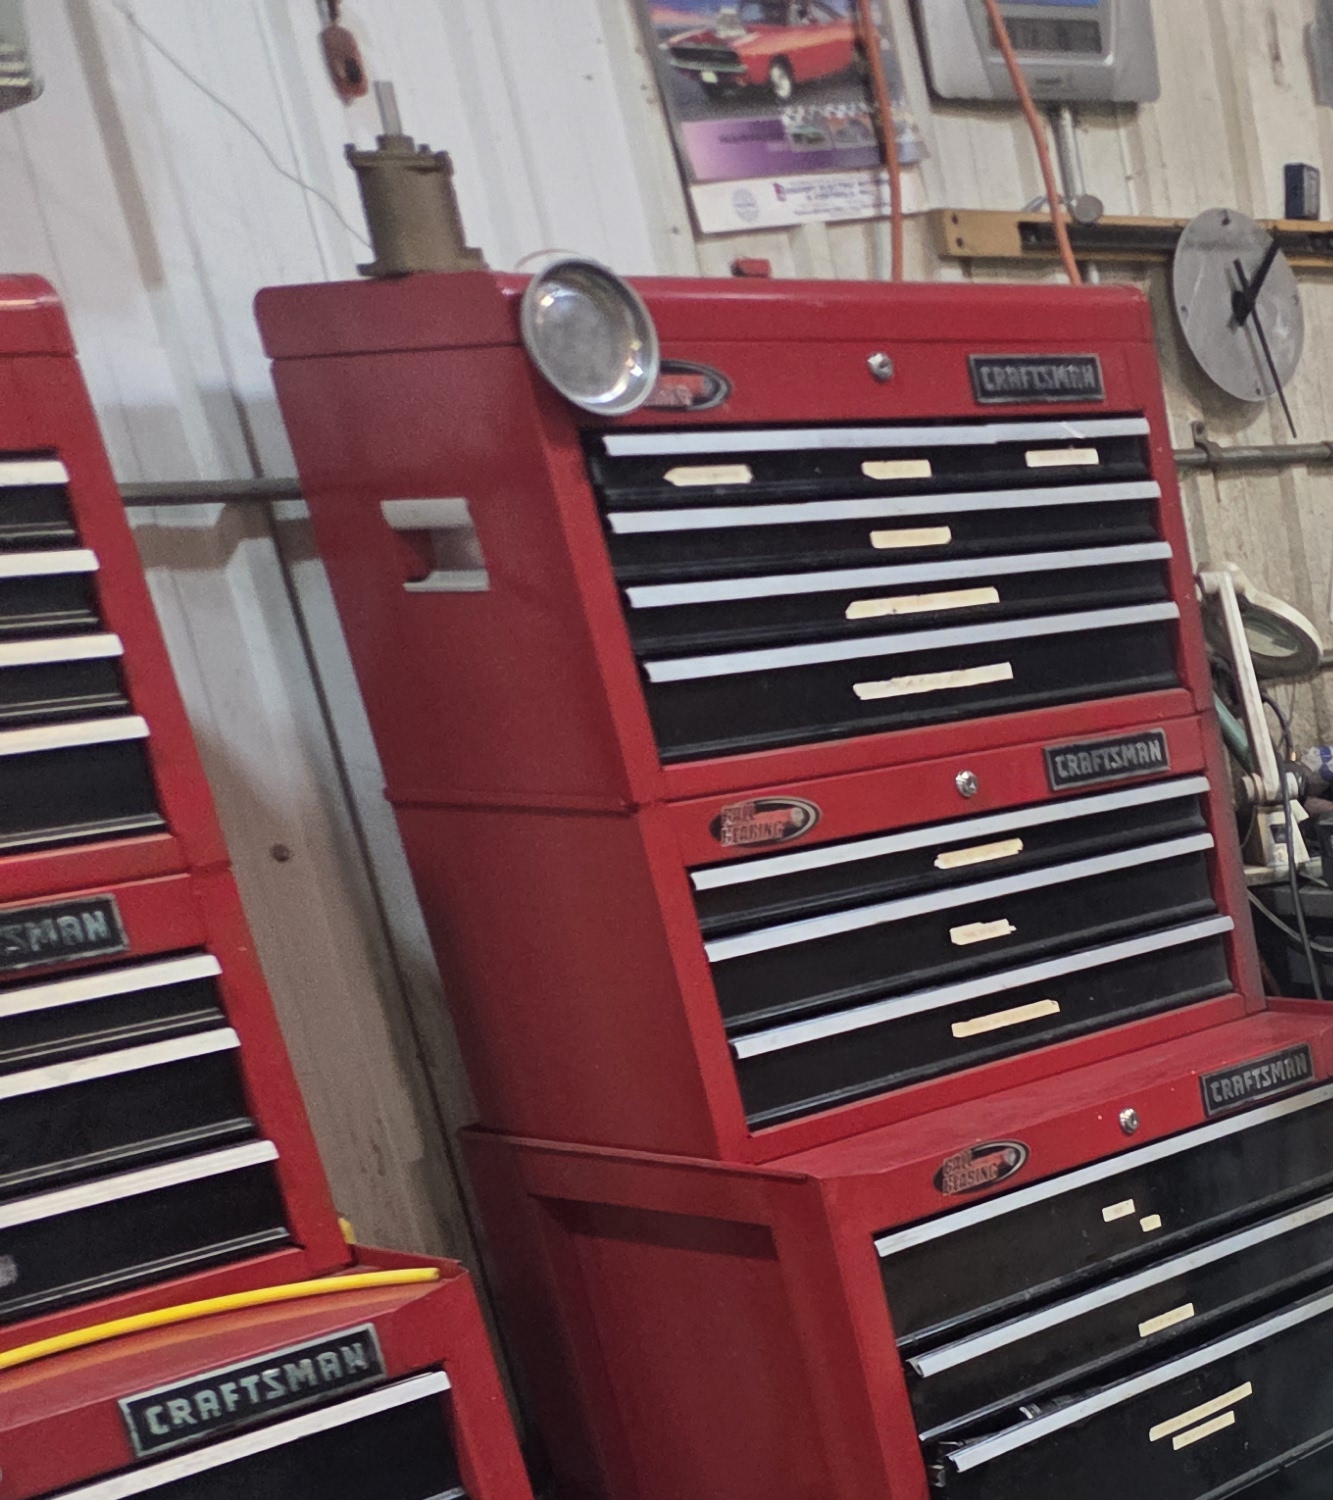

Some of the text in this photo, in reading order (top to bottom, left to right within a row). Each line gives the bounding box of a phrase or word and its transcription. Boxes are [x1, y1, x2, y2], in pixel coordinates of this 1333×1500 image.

[979, 364, 1096, 391] CRAFTSMAN
[1054, 739, 1163, 779] CRAFTSMAN
[1209, 1052, 1308, 1103] CRAFTSMAN
[145, 1342, 369, 1435] CRAFTSMAN
